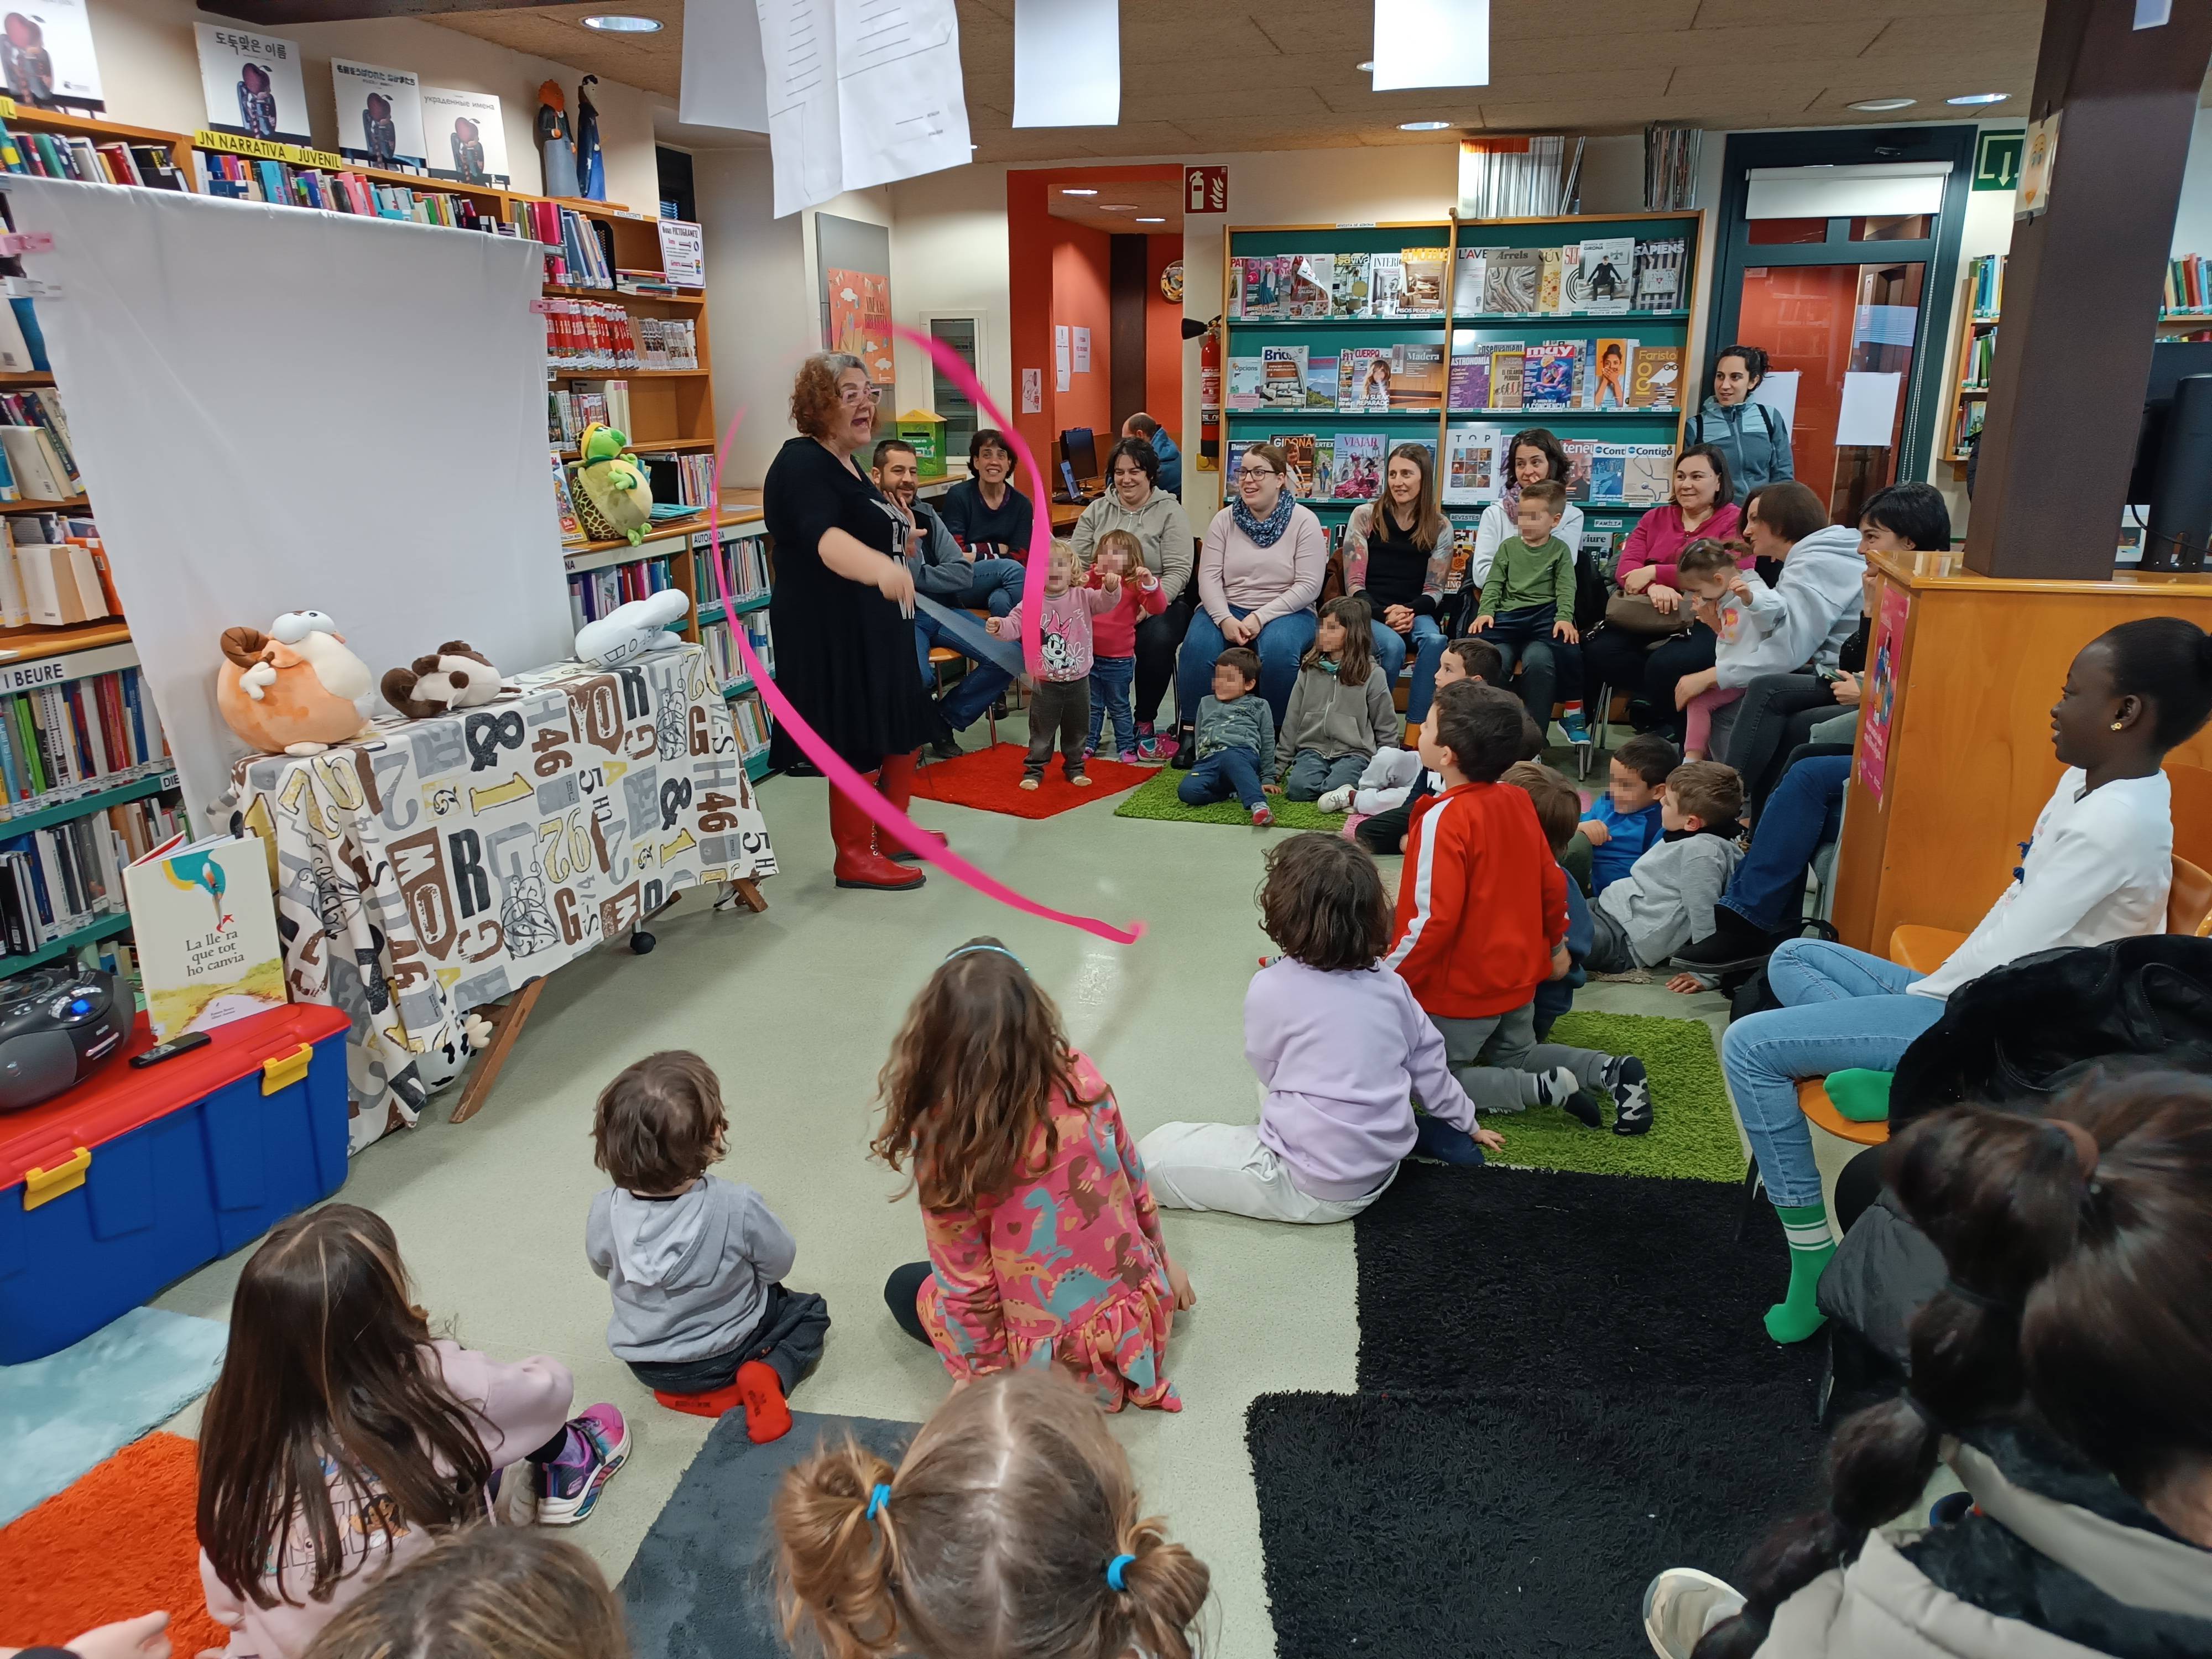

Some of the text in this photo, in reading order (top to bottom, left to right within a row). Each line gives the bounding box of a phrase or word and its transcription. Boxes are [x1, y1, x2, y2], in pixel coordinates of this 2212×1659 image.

[216, 32, 287, 60] 도둑맞은 이름
[424, 96, 495, 110] украденные имена
[200, 132, 340, 168] JN NARRATIVA JUVENIL
[1634, 241, 1685, 255] SÀPIENS
[1496, 251, 1528, 260] Arrels
[1265, 348, 1292, 361] Brico
[1407, 352, 1440, 361] Madera
[1526, 347, 1572, 357] muy
[1344, 436, 1377, 446] VIAJAR
[1636, 447, 1672, 456] Contigo
[14, 664, 64, 686] BEURE
[186, 940, 202, 951] La
[192, 943, 237, 965] que tot
[186, 952, 244, 977] ho canvia
